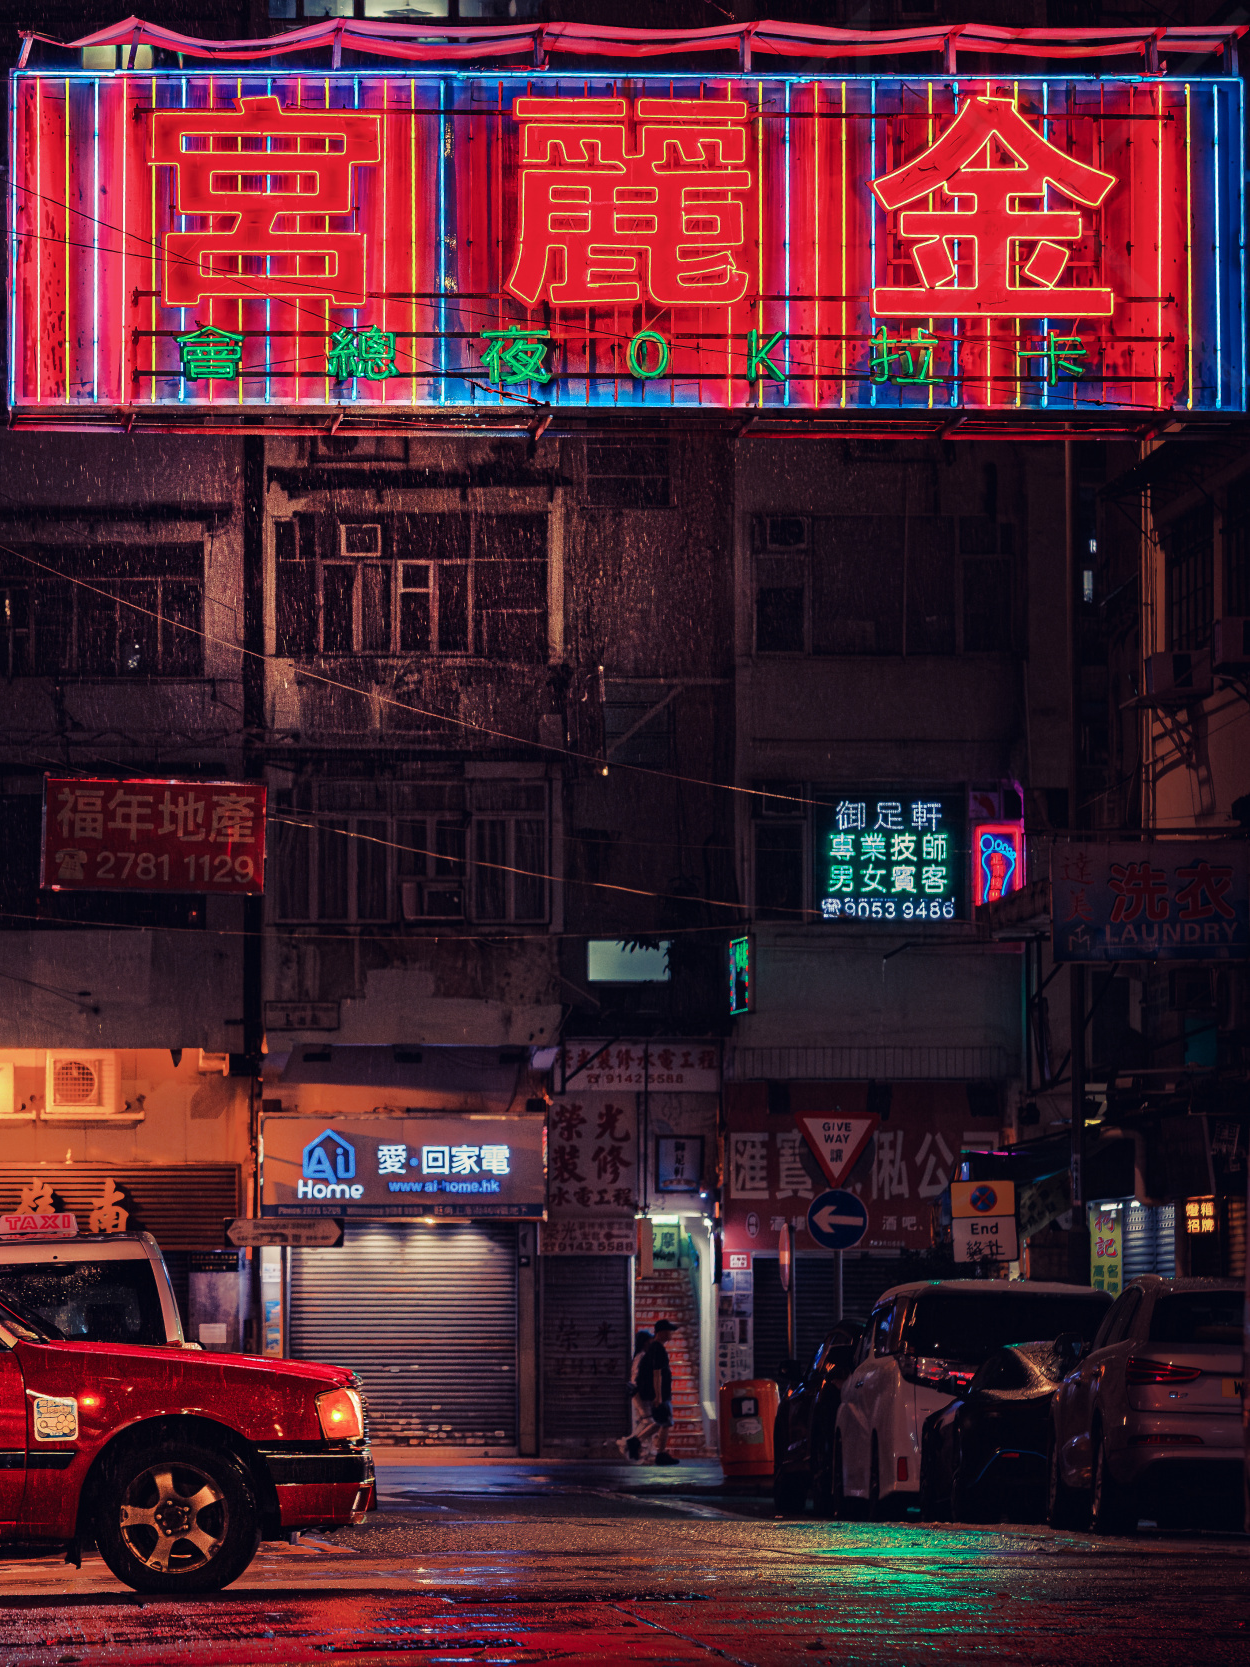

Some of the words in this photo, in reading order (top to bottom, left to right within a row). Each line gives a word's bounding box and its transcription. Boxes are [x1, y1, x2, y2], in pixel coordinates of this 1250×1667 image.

[56, 787, 256, 844] 福年地產
[835, 800, 943, 832] 御足軒
[828, 832, 949, 863] 專業技師
[96, 851, 170, 881] 2781
[183, 853, 255, 884] 1129
[828, 863, 949, 894] 男女賓客
[1107, 860, 1236, 923] 洗衣
[844, 897, 896, 919] 9053
[902, 897, 956, 919] 9486
[1105, 921, 1239, 944] LAUNDRY
[550, 1103, 632, 1142] 榮光
[822, 1121, 852, 1133] GIVE
[823, 1133, 850, 1145] WAY
[551, 1144, 633, 1185] 裝修
[297, 1178, 365, 1199] Home
[388, 1180, 501, 1194] www.ai-home.hk
[549, 1186, 634, 1207] 水電工程
[5, 1214, 72, 1232] TAXI
[970, 1221, 999, 1236] End
